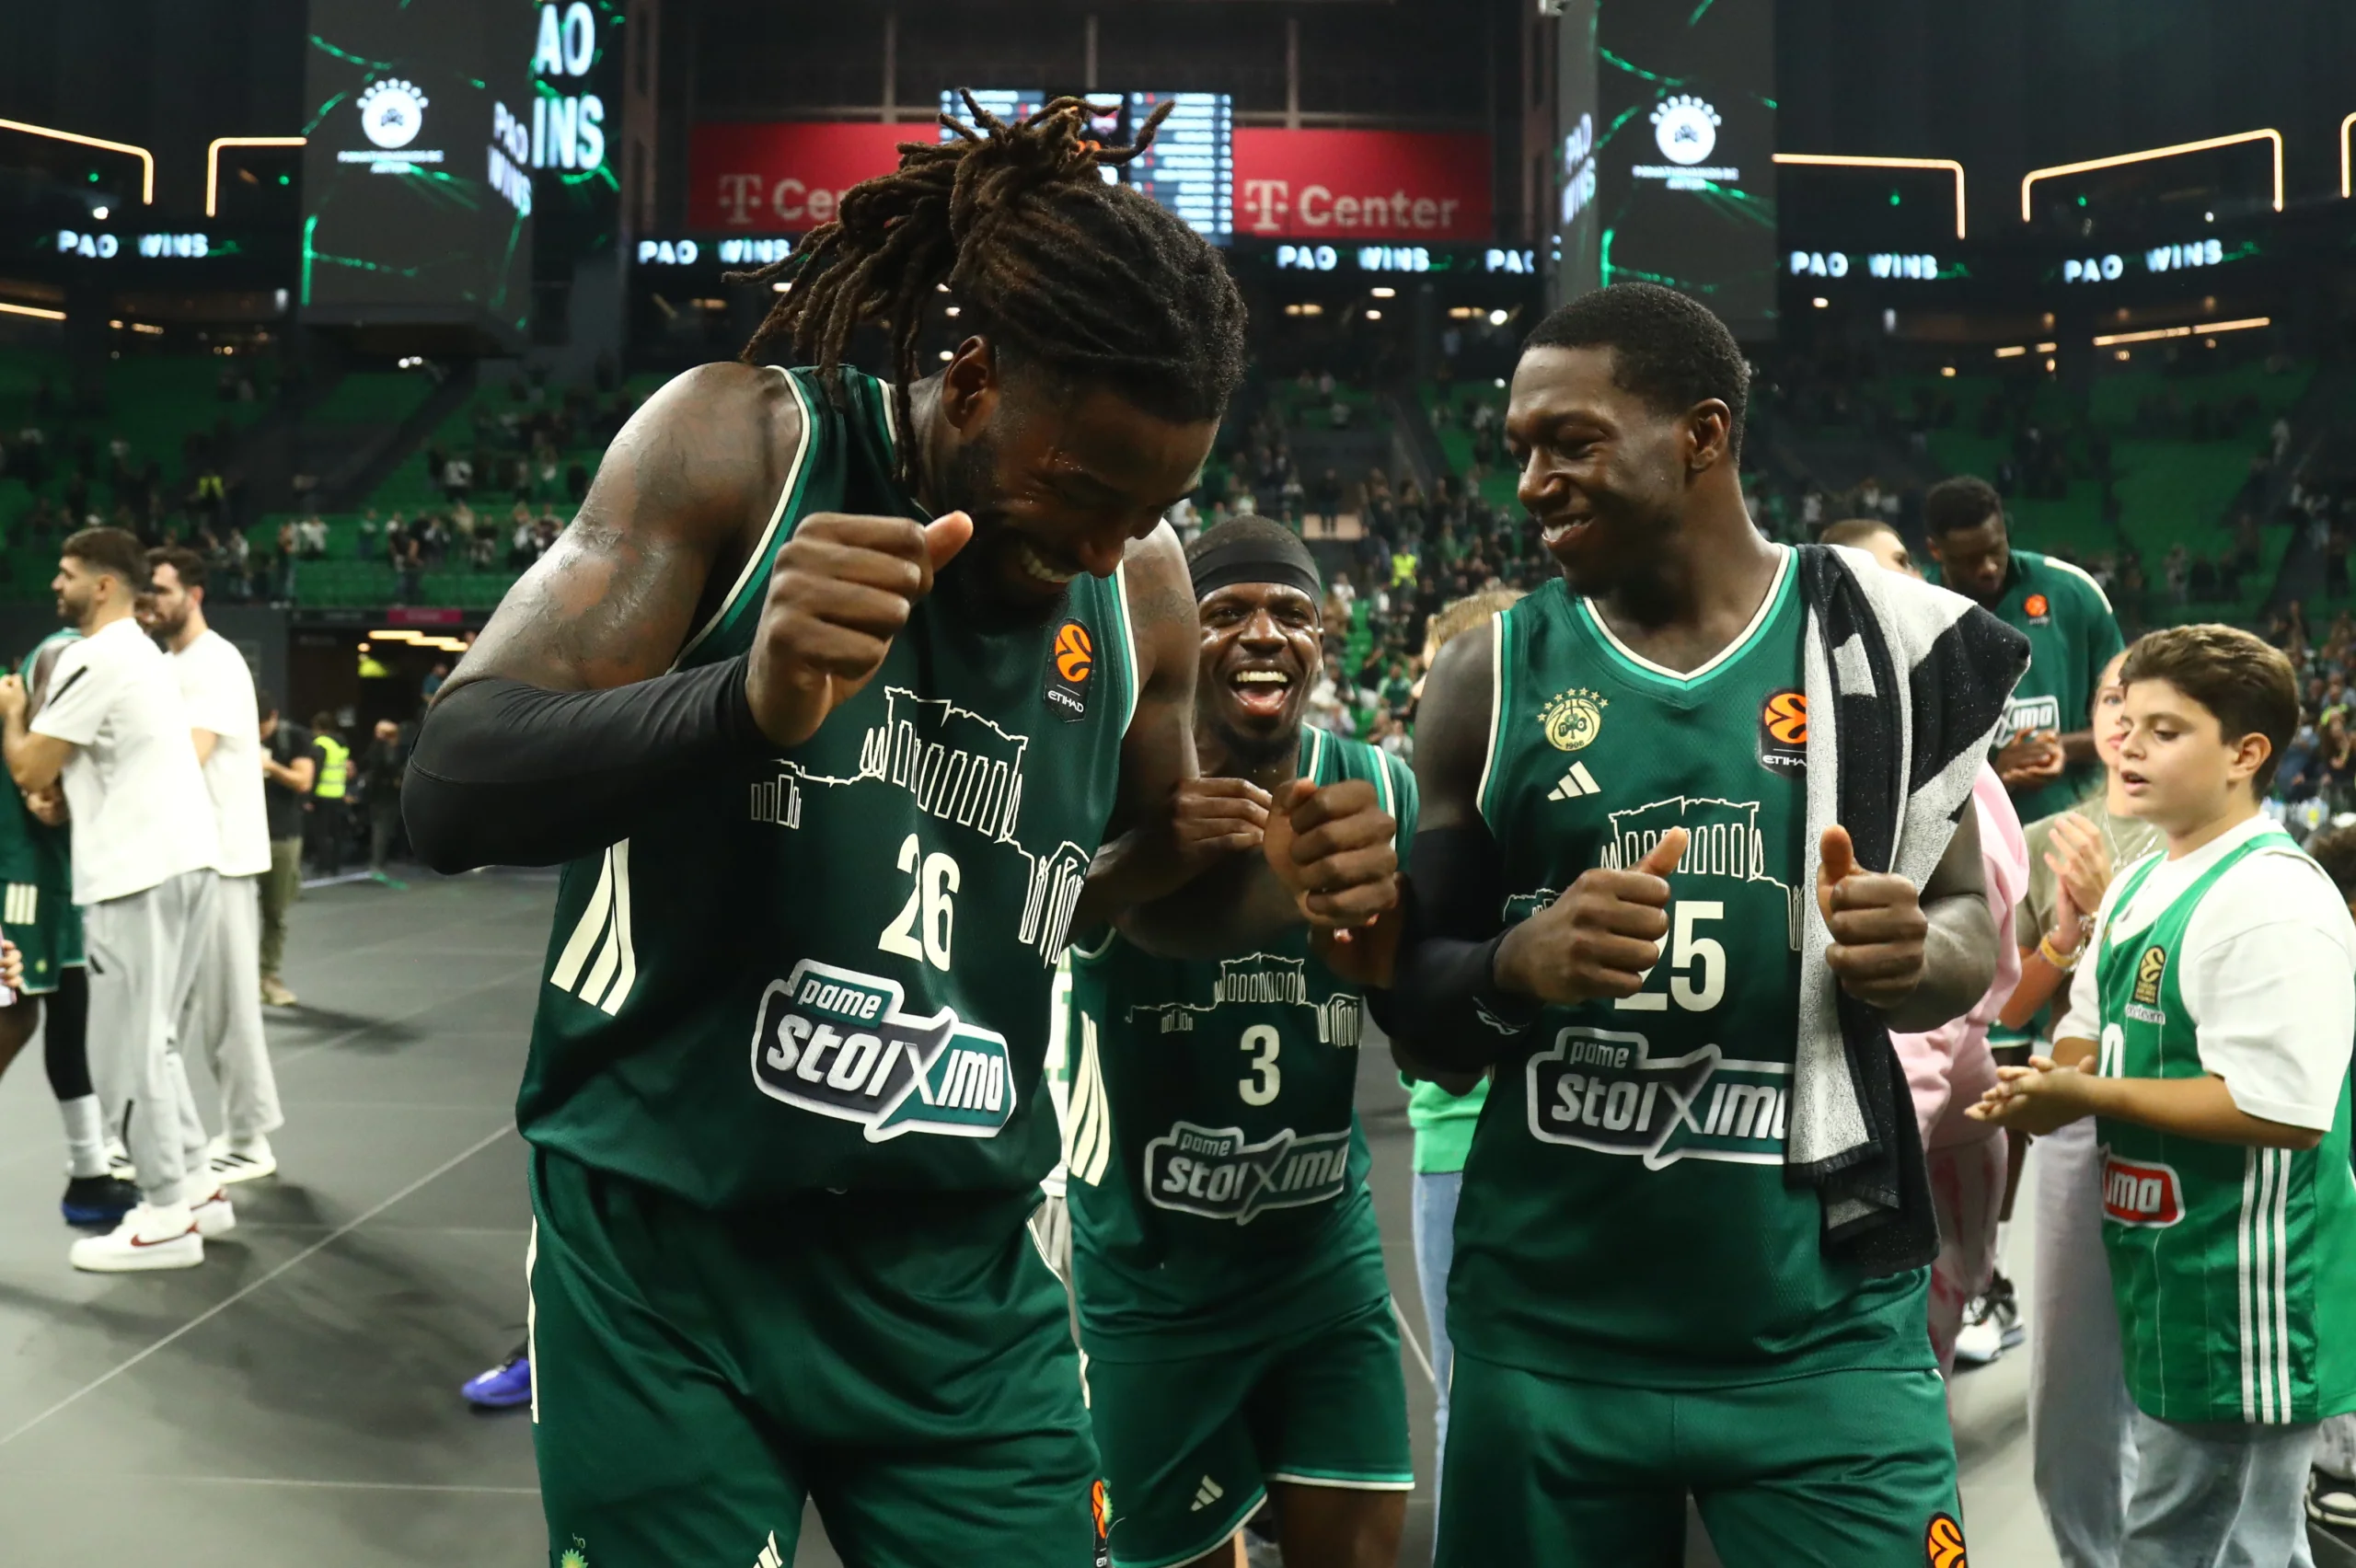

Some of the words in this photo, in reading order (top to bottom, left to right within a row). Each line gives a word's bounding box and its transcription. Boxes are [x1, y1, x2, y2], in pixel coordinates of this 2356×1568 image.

[1299, 184, 1460, 229] Center
[58, 229, 119, 259] PAO
[139, 233, 209, 258] WINS
[638, 239, 698, 265] PAO
[718, 237, 791, 264] WINS
[1277, 246, 1337, 271] PAO
[1358, 247, 1429, 271] WINS
[1791, 251, 1849, 277] PAO
[1868, 253, 1938, 280] WINS
[2064, 254, 2123, 282] PAO
[2146, 239, 2223, 272] WINS
[1047, 689, 1084, 713] ETIHAD
[878, 834, 961, 972] 26
[798, 978, 882, 1020] pame
[1239, 1024, 1281, 1106] 3
[1570, 1041, 1630, 1068] pame
[1180, 1133, 1231, 1158] pame
